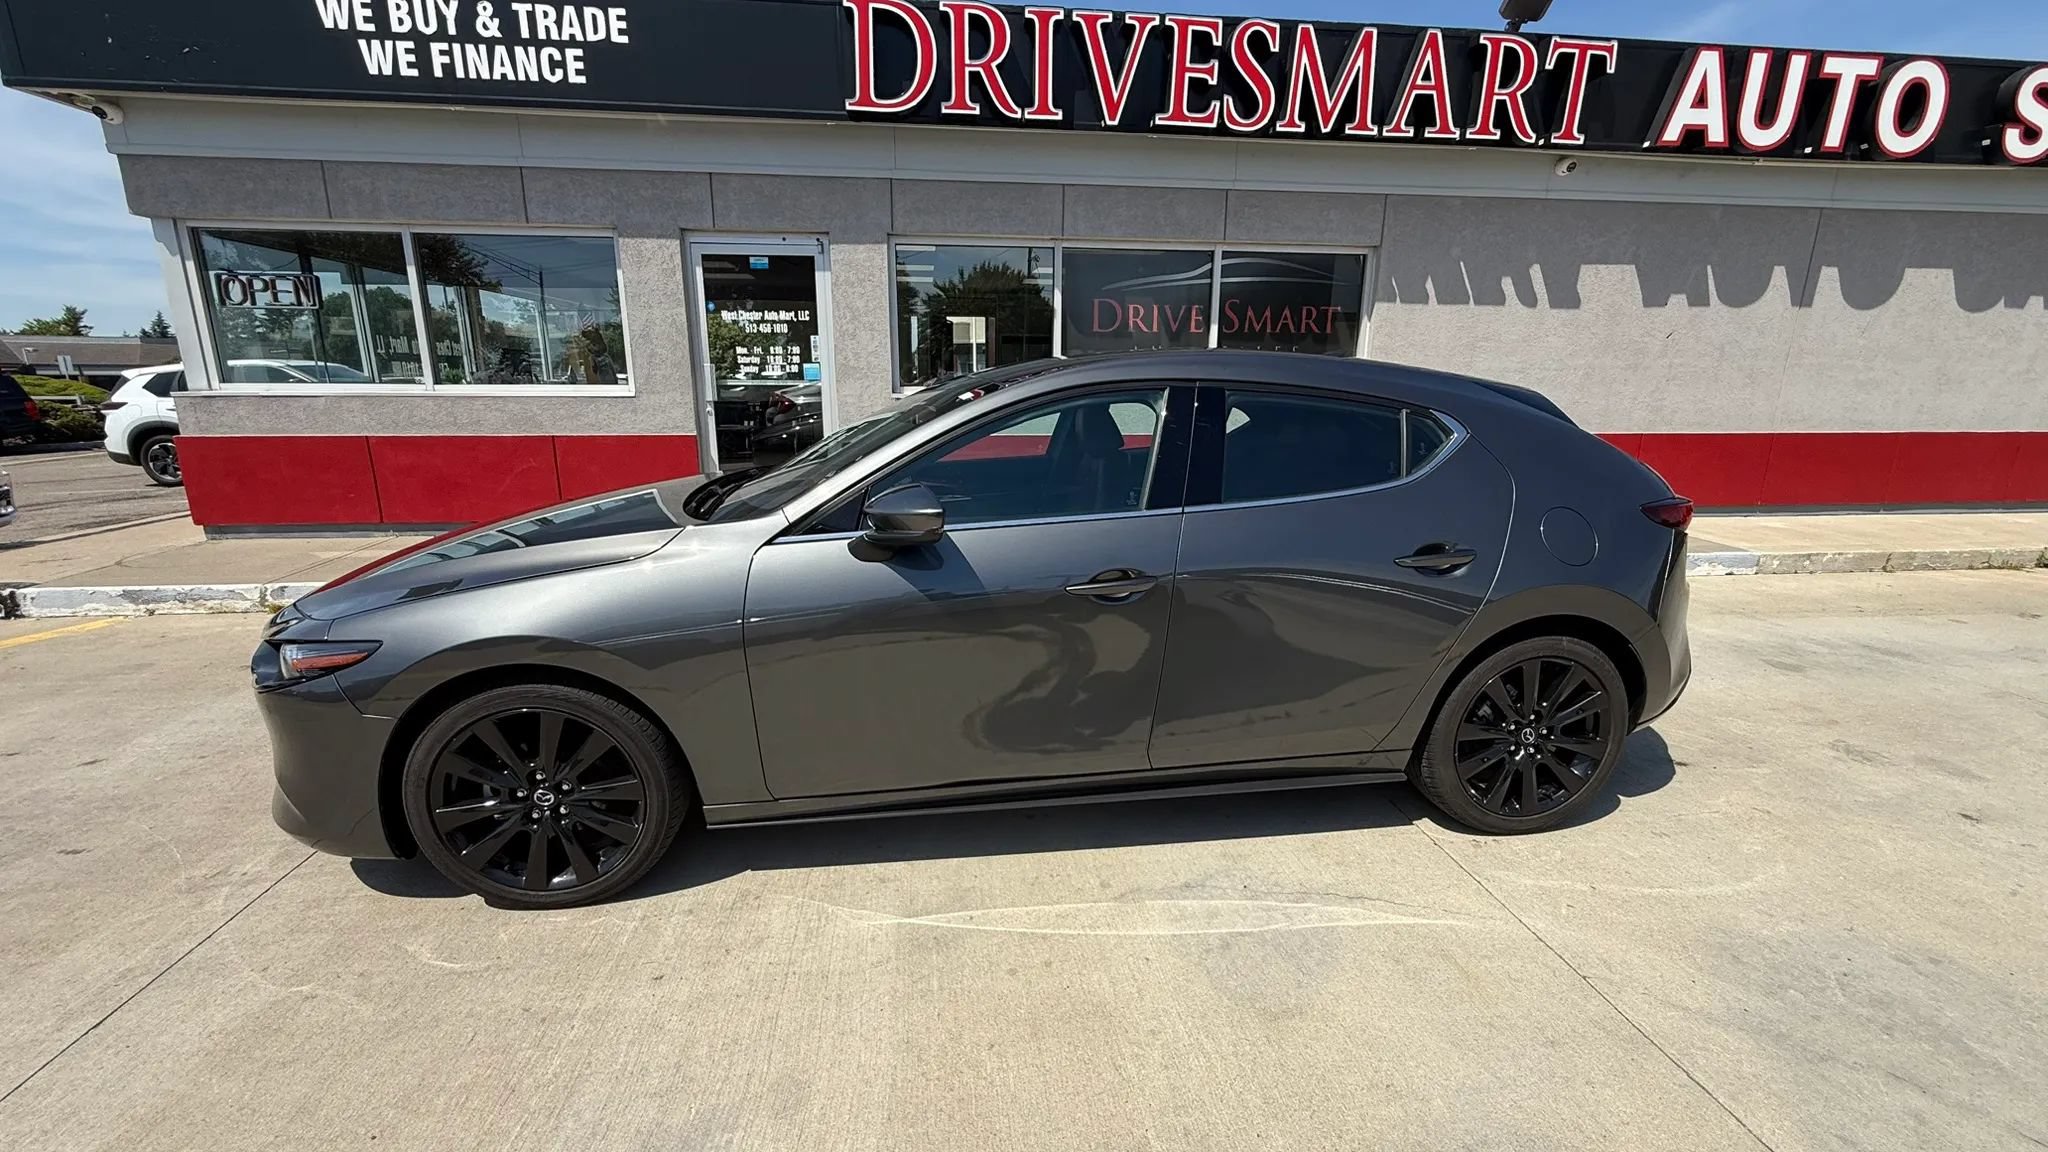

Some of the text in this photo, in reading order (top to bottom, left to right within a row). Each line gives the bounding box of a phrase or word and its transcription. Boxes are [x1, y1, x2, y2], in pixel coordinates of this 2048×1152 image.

[315, 0, 630, 43] WE BUY & TRADE
[357, 39, 588, 84] WE FINANCE
[1656, 45, 1951, 160] AUTO
[221, 275, 315, 307] OPEN
[721, 310, 737, 321] West
[738, 310, 763, 322] Chester
[764, 310, 778, 321] Auto
[798, 310, 810, 321] LLC
[737, 355, 760, 365] Saturday
